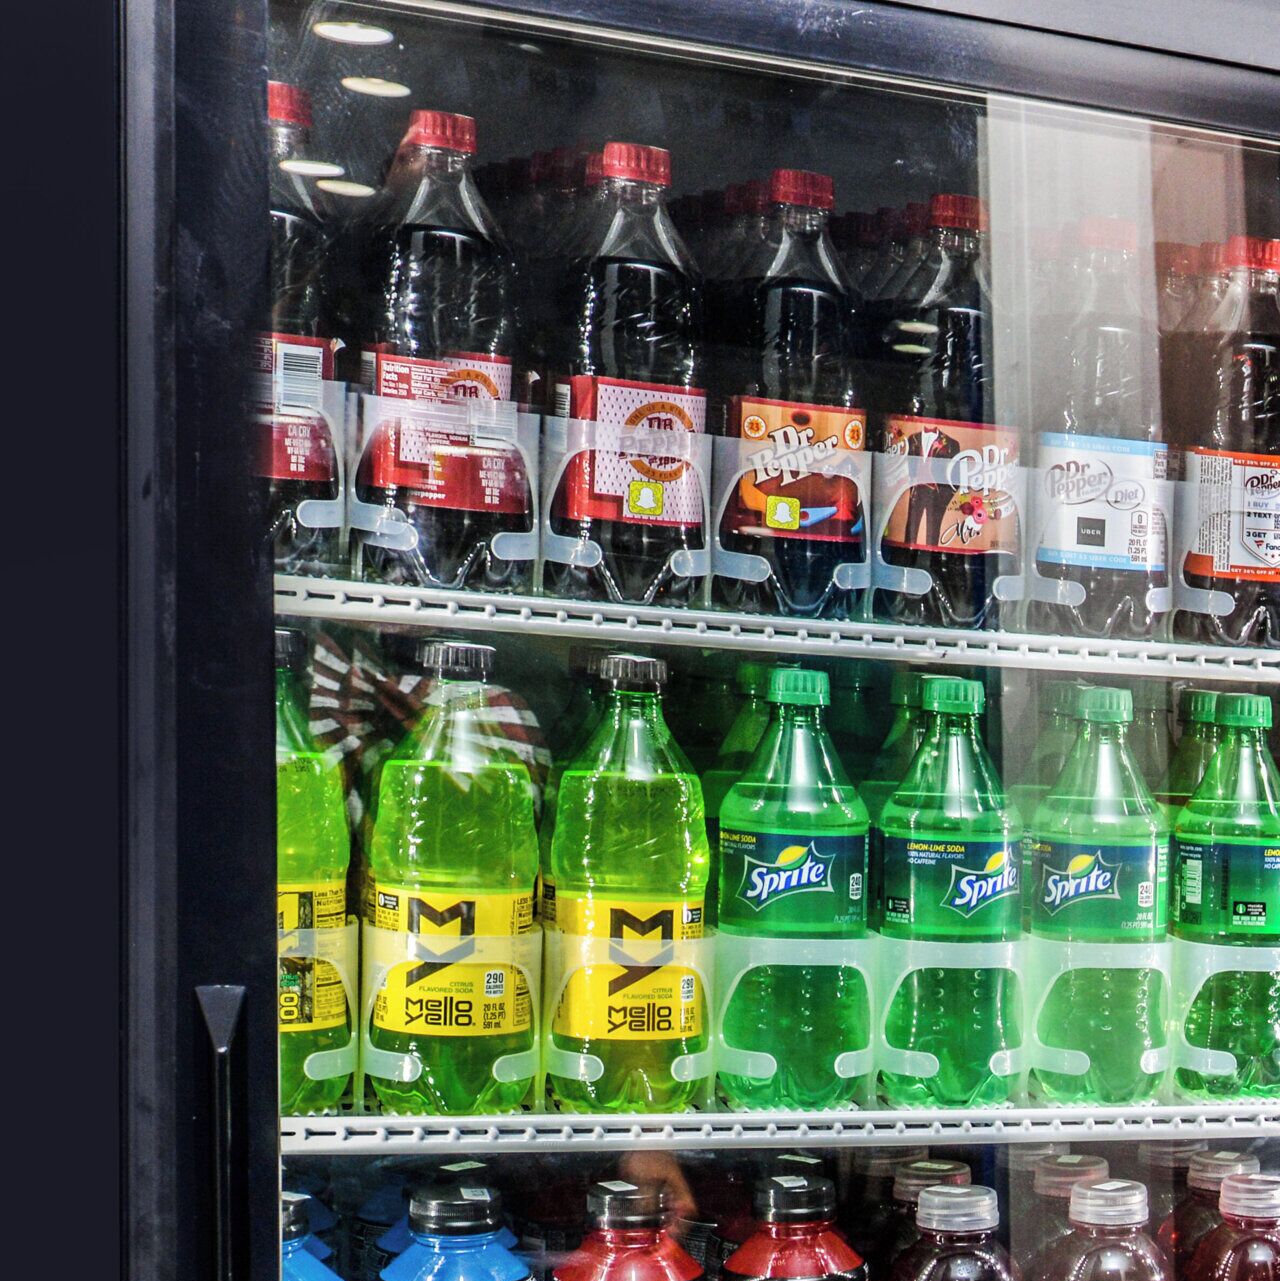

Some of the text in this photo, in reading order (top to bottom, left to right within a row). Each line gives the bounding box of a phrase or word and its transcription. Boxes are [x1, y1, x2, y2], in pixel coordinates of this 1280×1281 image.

[770, 425, 815, 451] Dr
[748, 434, 839, 487] Pepper
[1066, 459, 1091, 475] Dr
[1113, 487, 1139, 504] Diet
[1081, 528, 1102, 536] UBER
[947, 844, 965, 853] SODA
[746, 854, 826, 900] Sprite
[953, 859, 1018, 906] Sprite
[1044, 866, 1112, 906] Sprite
[486, 972, 504, 984] 290
